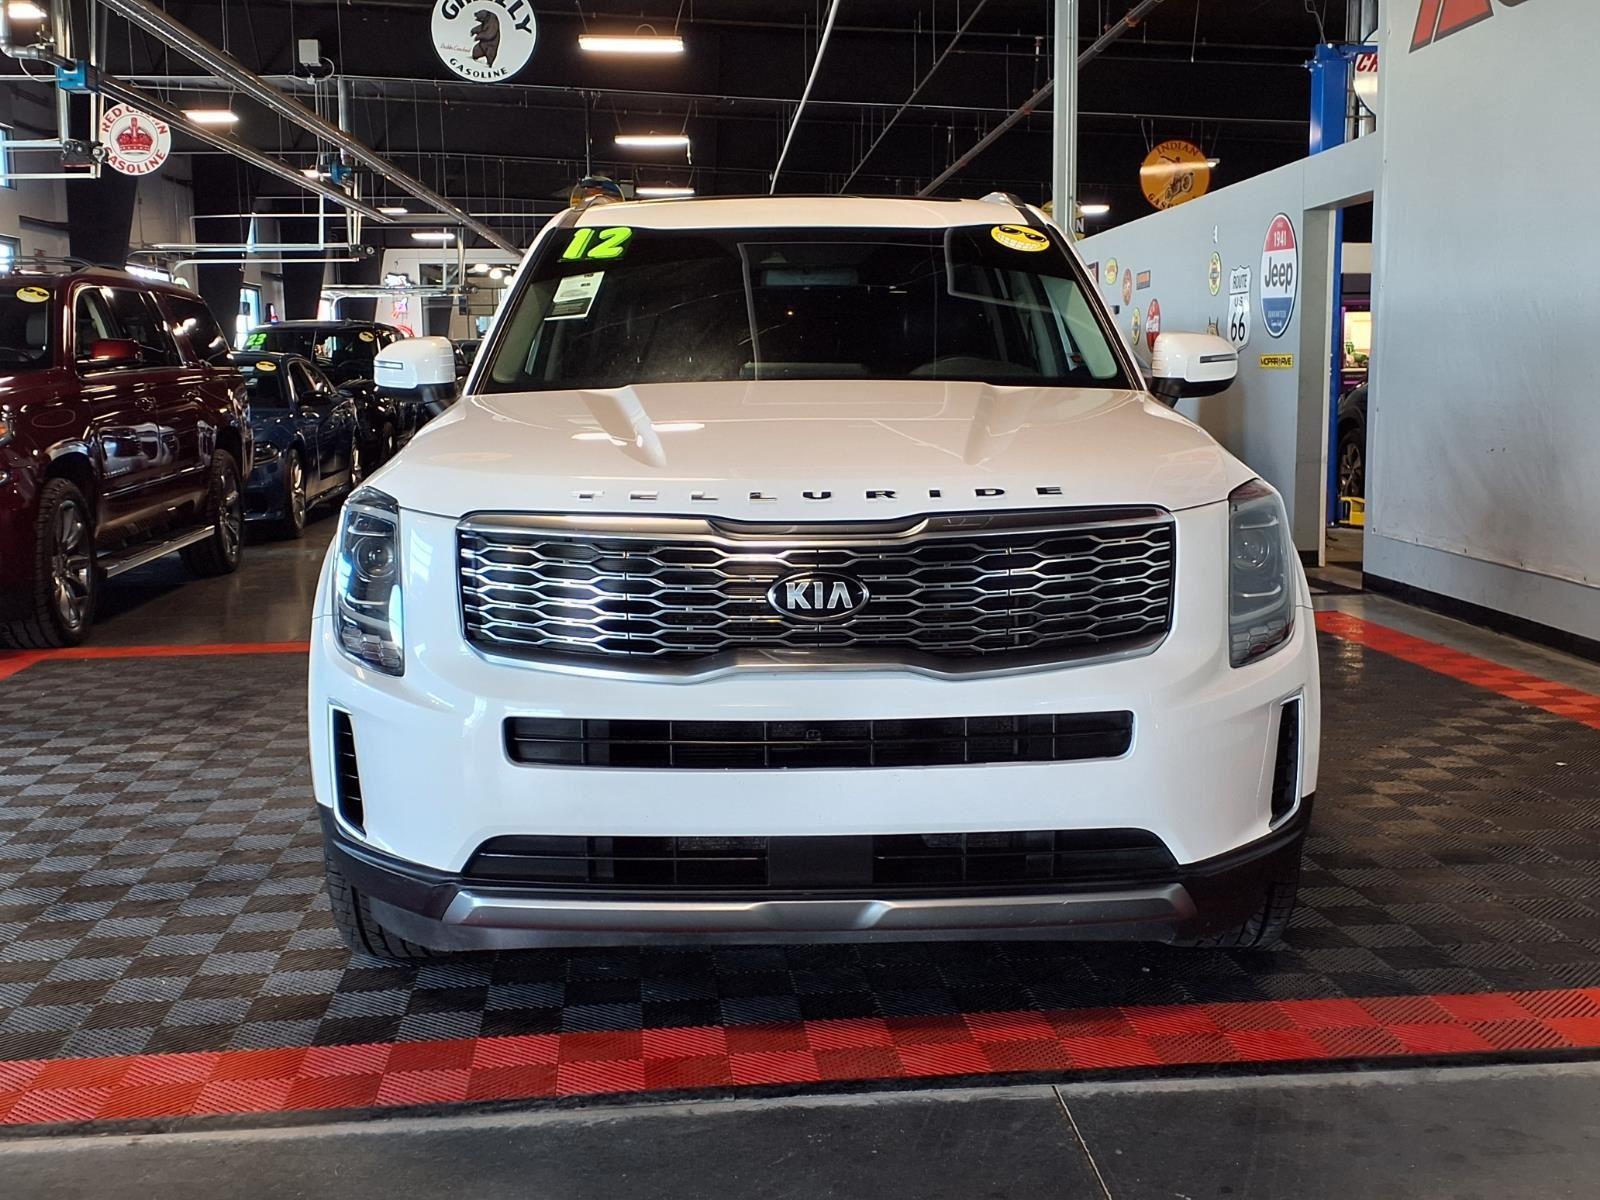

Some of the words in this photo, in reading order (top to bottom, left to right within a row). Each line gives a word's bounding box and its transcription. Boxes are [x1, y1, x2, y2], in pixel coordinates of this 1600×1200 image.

[449, 58, 508, 78] GASOLINE
[102, 107, 122, 133] RED
[1156, 142, 1200, 157] INDIAN
[563, 227, 632, 259] 12
[1273, 230, 1287, 247] 1941
[1232, 274, 1248, 290] ROUTE
[1264, 256, 1293, 294] Jeep
[1230, 312, 1246, 342] 66
[246, 333, 267, 346] 23
[570, 486, 1064, 501] TELLURIDE
[785, 581, 854, 610] KIA
